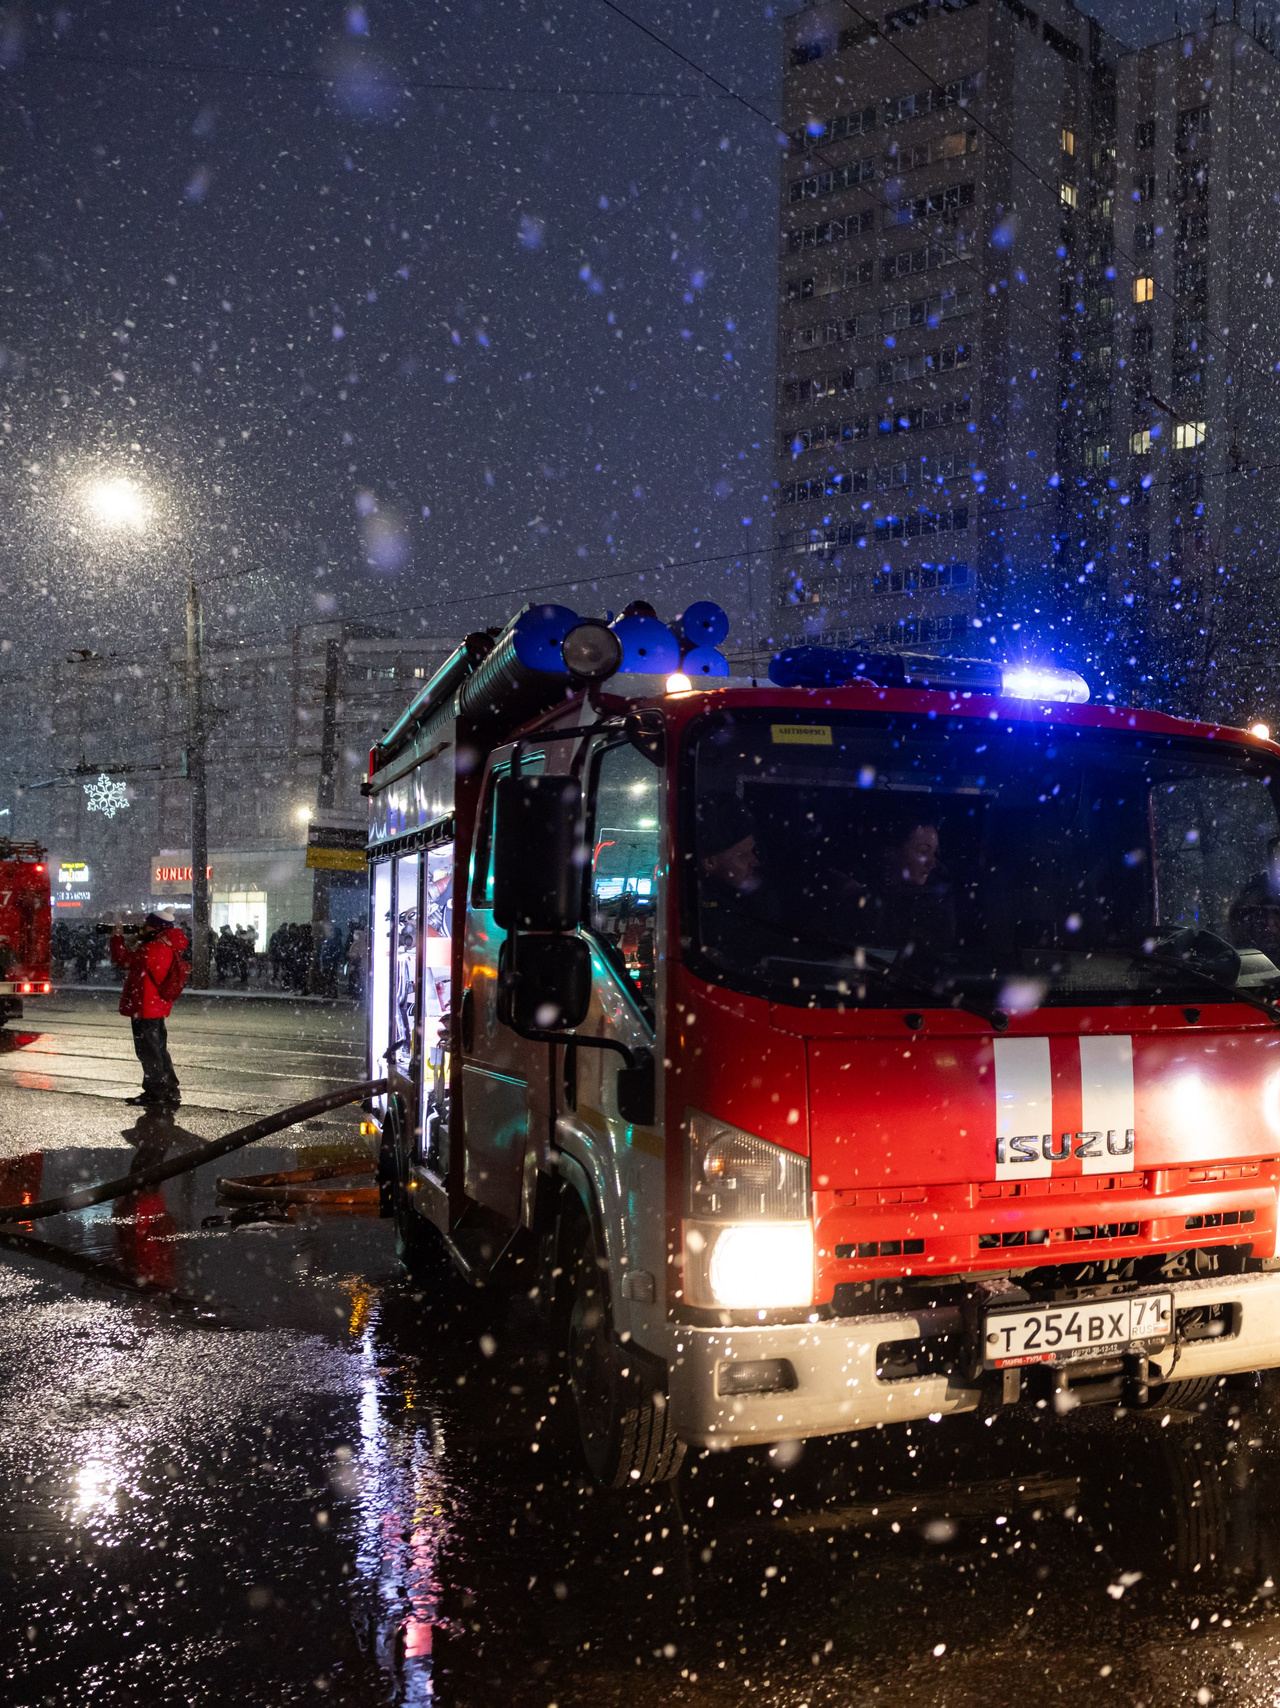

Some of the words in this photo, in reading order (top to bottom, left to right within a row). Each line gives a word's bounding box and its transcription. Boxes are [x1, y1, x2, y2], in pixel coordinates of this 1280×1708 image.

[155, 865, 213, 881] SUNLIT
[996, 1129, 1135, 1164] ISUZU
[1134, 1298, 1161, 1325] 71
[1132, 1325, 1152, 1336] RUS
